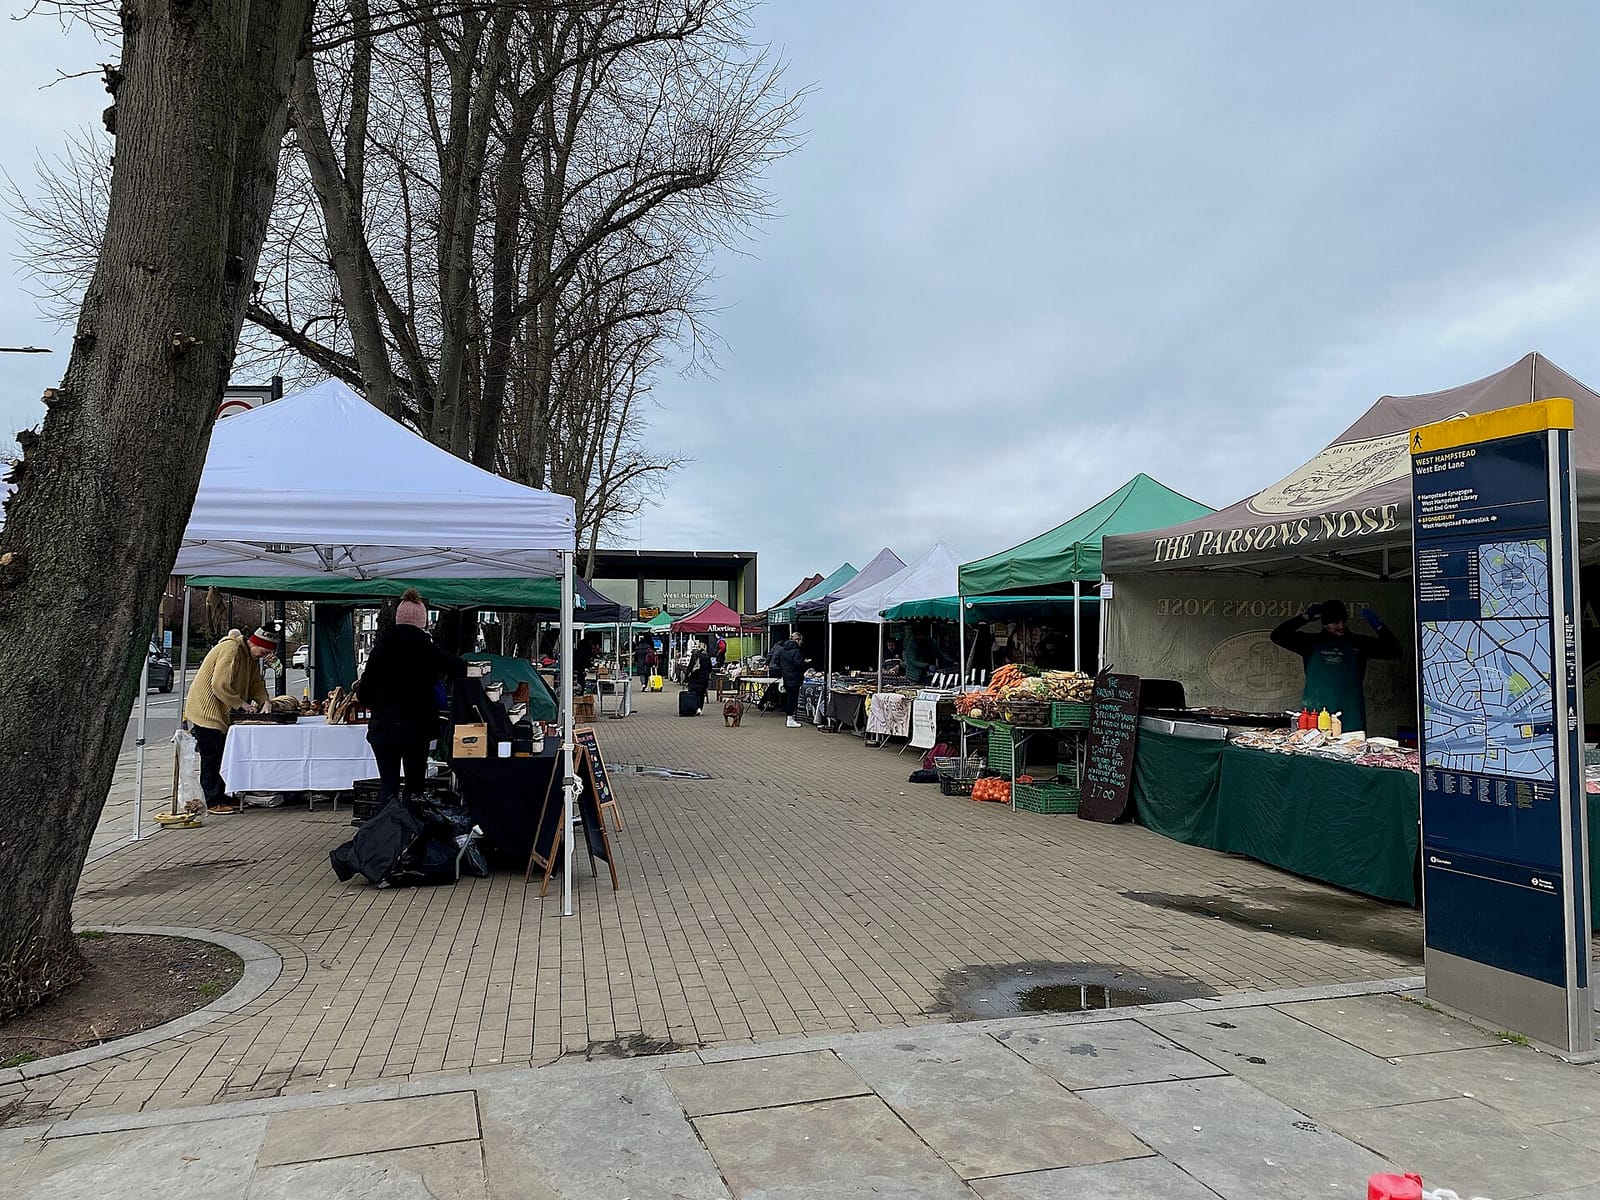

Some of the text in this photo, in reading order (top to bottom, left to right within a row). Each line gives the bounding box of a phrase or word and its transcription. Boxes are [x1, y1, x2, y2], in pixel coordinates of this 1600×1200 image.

[1416, 449, 1476, 466] WEST HAMPSTEAD
[1416, 461, 1465, 475] West End Lane
[1153, 503, 1401, 563] THE PARSONS NOSE
[681, 592, 718, 600] Hampstead
[708, 624, 736, 632] Albertine
